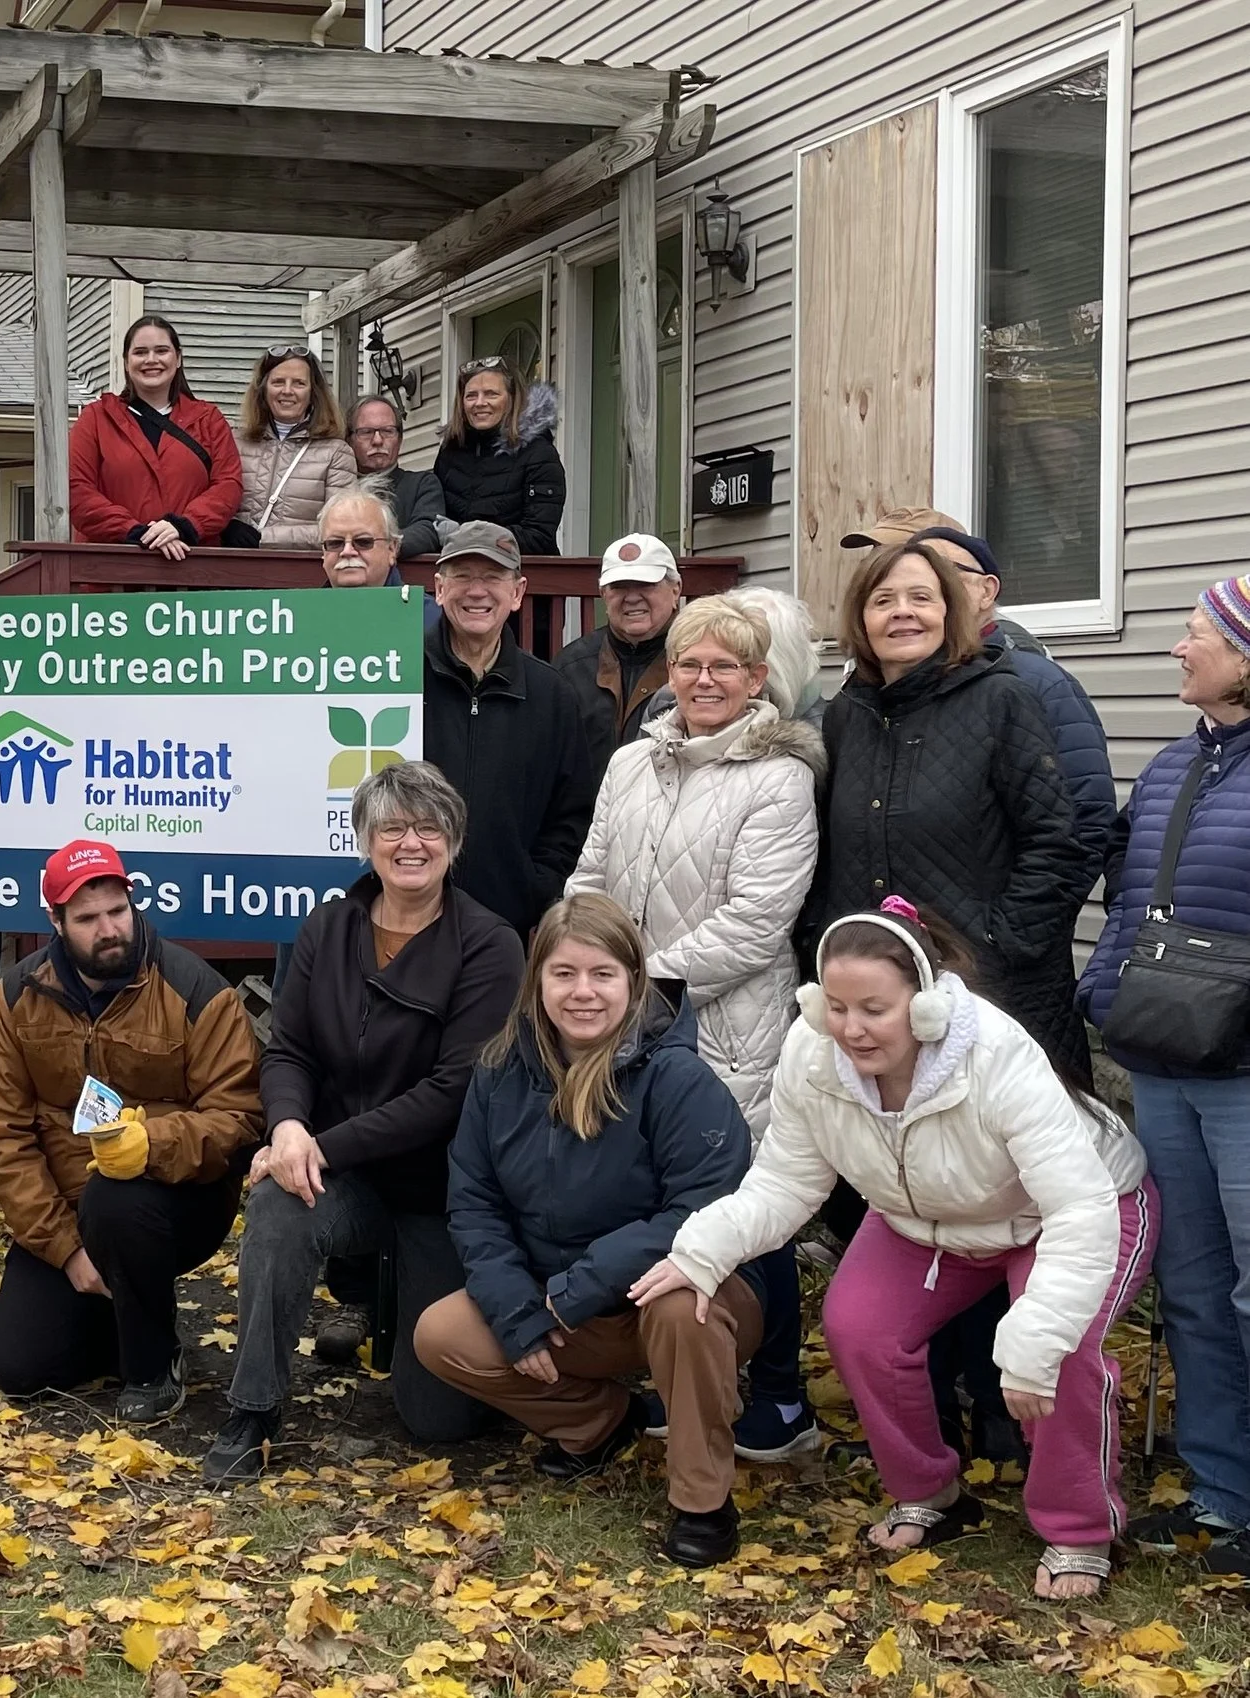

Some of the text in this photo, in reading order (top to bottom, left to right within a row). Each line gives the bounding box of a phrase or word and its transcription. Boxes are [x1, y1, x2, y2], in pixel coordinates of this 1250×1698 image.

[144, 598, 294, 637] Church
[38, 648, 224, 685] Outreach
[242, 647, 401, 692] Project
[84, 739, 232, 780] Habitat
[84, 783, 116, 805] for
[84, 813, 203, 837] Capital Region
[69, 849, 102, 863] LINCS
